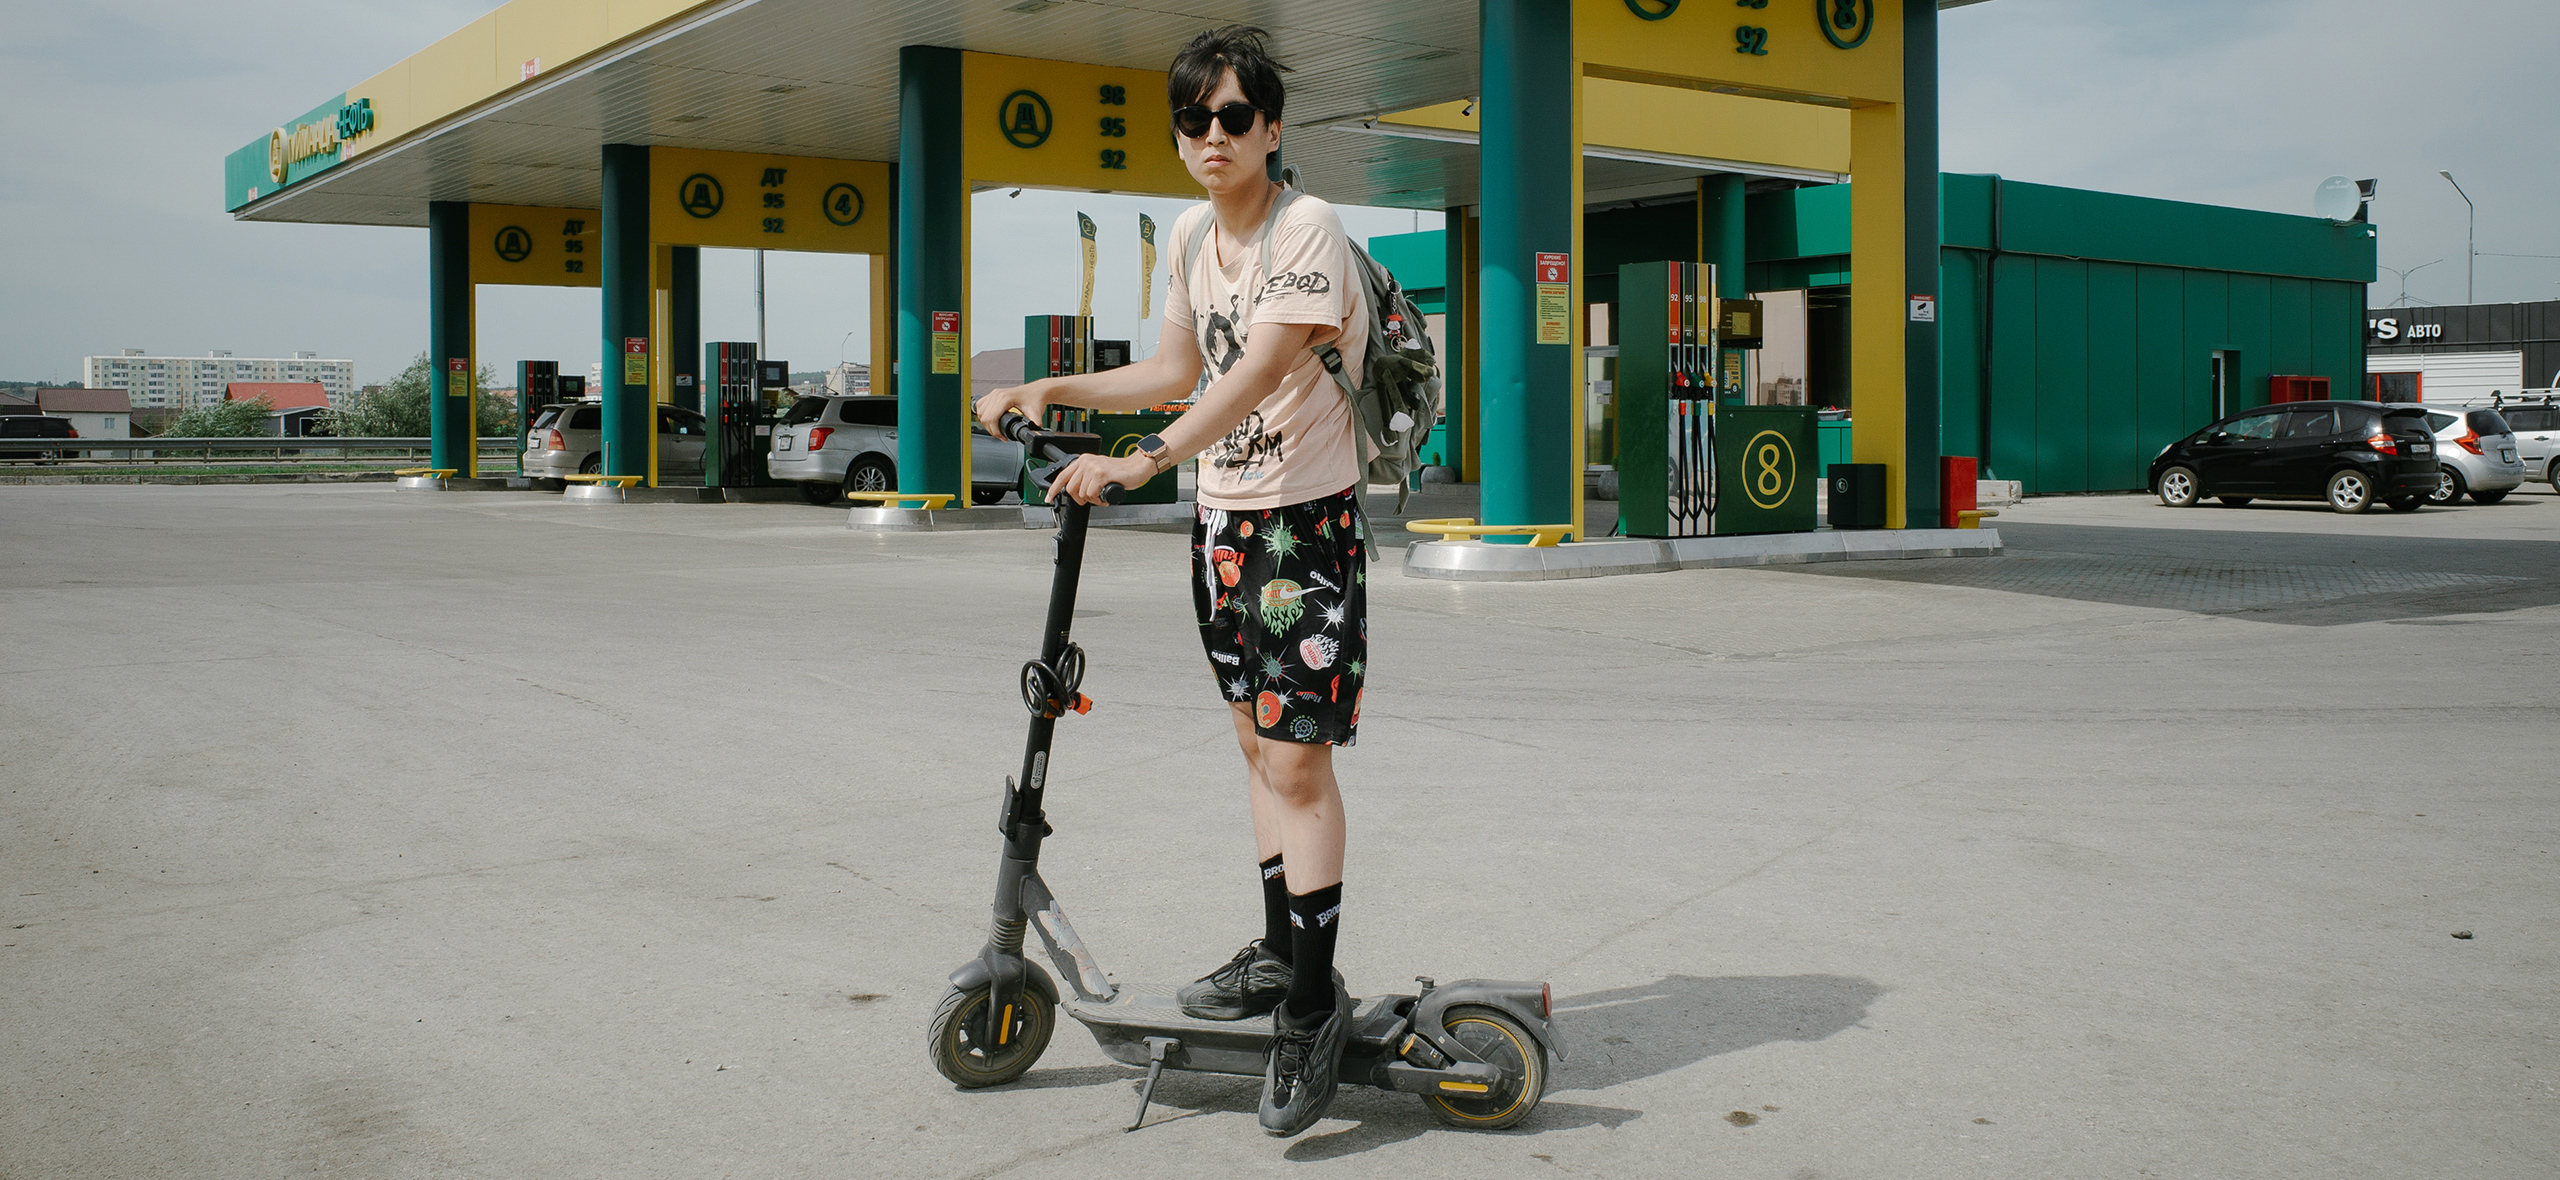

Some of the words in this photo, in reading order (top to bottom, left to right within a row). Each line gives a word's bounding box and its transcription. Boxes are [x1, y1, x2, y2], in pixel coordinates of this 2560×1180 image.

[1736, 25, 1769, 56] 92
[1099, 84, 1126, 106] 98
[1100, 117, 1126, 138] 95
[1100, 149, 1127, 170] 92
[760, 167, 788, 188] ДТ
[762, 192, 785, 209] 95
[834, 193, 852, 216] 4
[562, 219, 585, 236] ДТ
[762, 217, 785, 234] 92
[564, 239, 584, 253] 95
[564, 259, 584, 274] 92
[1670, 293, 1679, 302] 92
[1685, 294, 1693, 303] 95
[1699, 295, 1707, 303] 98
[2406, 323, 2443, 339] АВТО
[1757, 443, 1782, 496] 8
